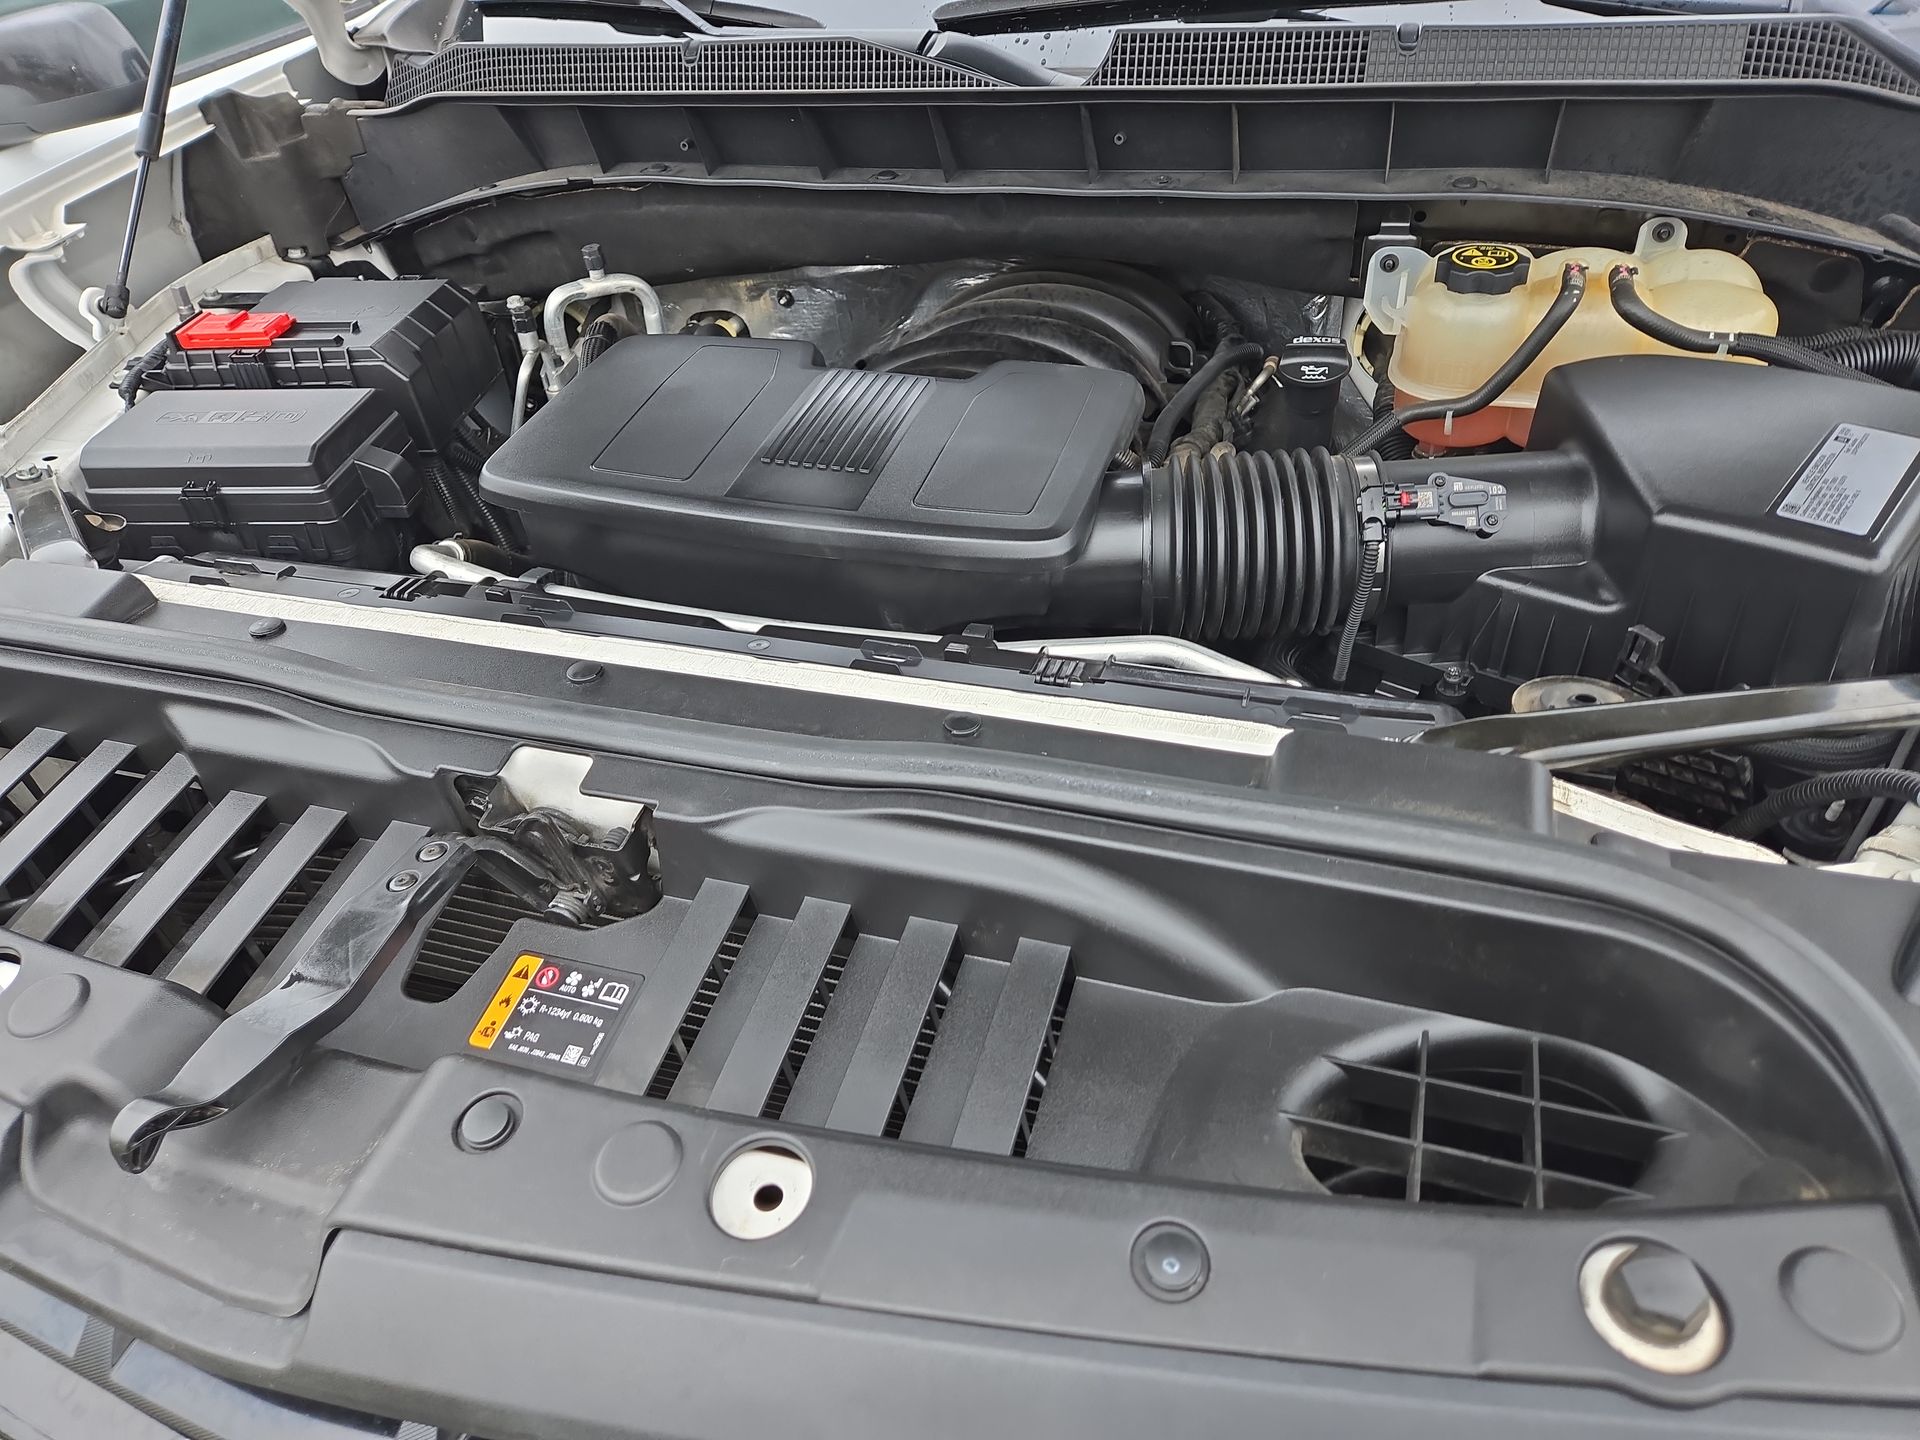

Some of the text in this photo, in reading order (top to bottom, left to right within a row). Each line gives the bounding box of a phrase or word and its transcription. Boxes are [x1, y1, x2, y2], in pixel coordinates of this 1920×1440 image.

[1293, 336, 1341, 344] dexos
[559, 984, 577, 994] AUTO
[539, 1004, 572, 1020] R-1234yf
[592, 1016, 604, 1028] kg
[523, 1031, 540, 1043] PAG
